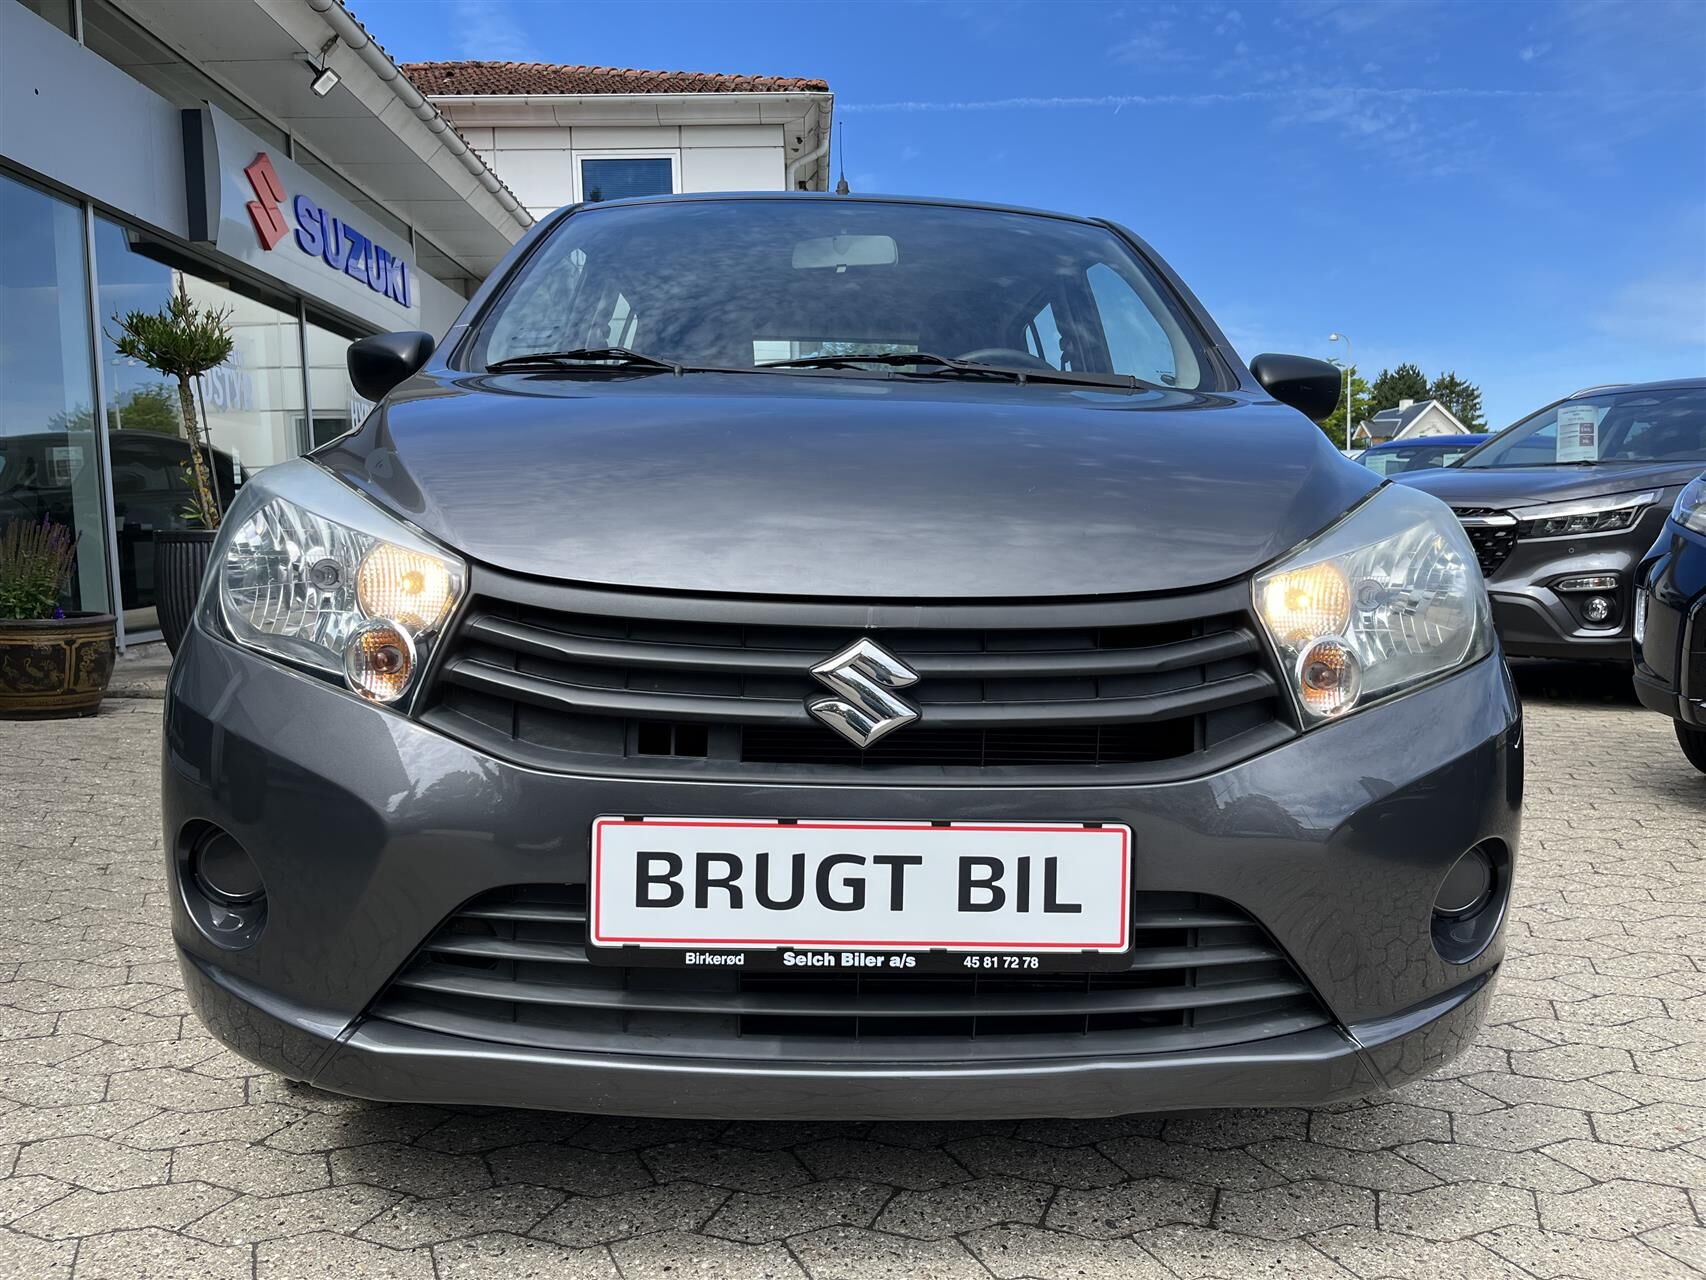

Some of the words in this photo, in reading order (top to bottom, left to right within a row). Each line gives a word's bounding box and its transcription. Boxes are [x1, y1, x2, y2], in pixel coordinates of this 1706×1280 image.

[294, 194, 411, 309] SUZUKI
[635, 850, 923, 912] BRUGT
[957, 855, 1083, 914] BIL
[685, 951, 745, 966] Birkerød
[783, 951, 836, 967] Selch
[841, 952, 885, 968] Biler
[889, 953, 917, 968] a/s
[963, 956, 980, 969] 45
[983, 956, 999, 969] 81
[1003, 956, 1020, 969] 72
[1022, 957, 1039, 969] 78
